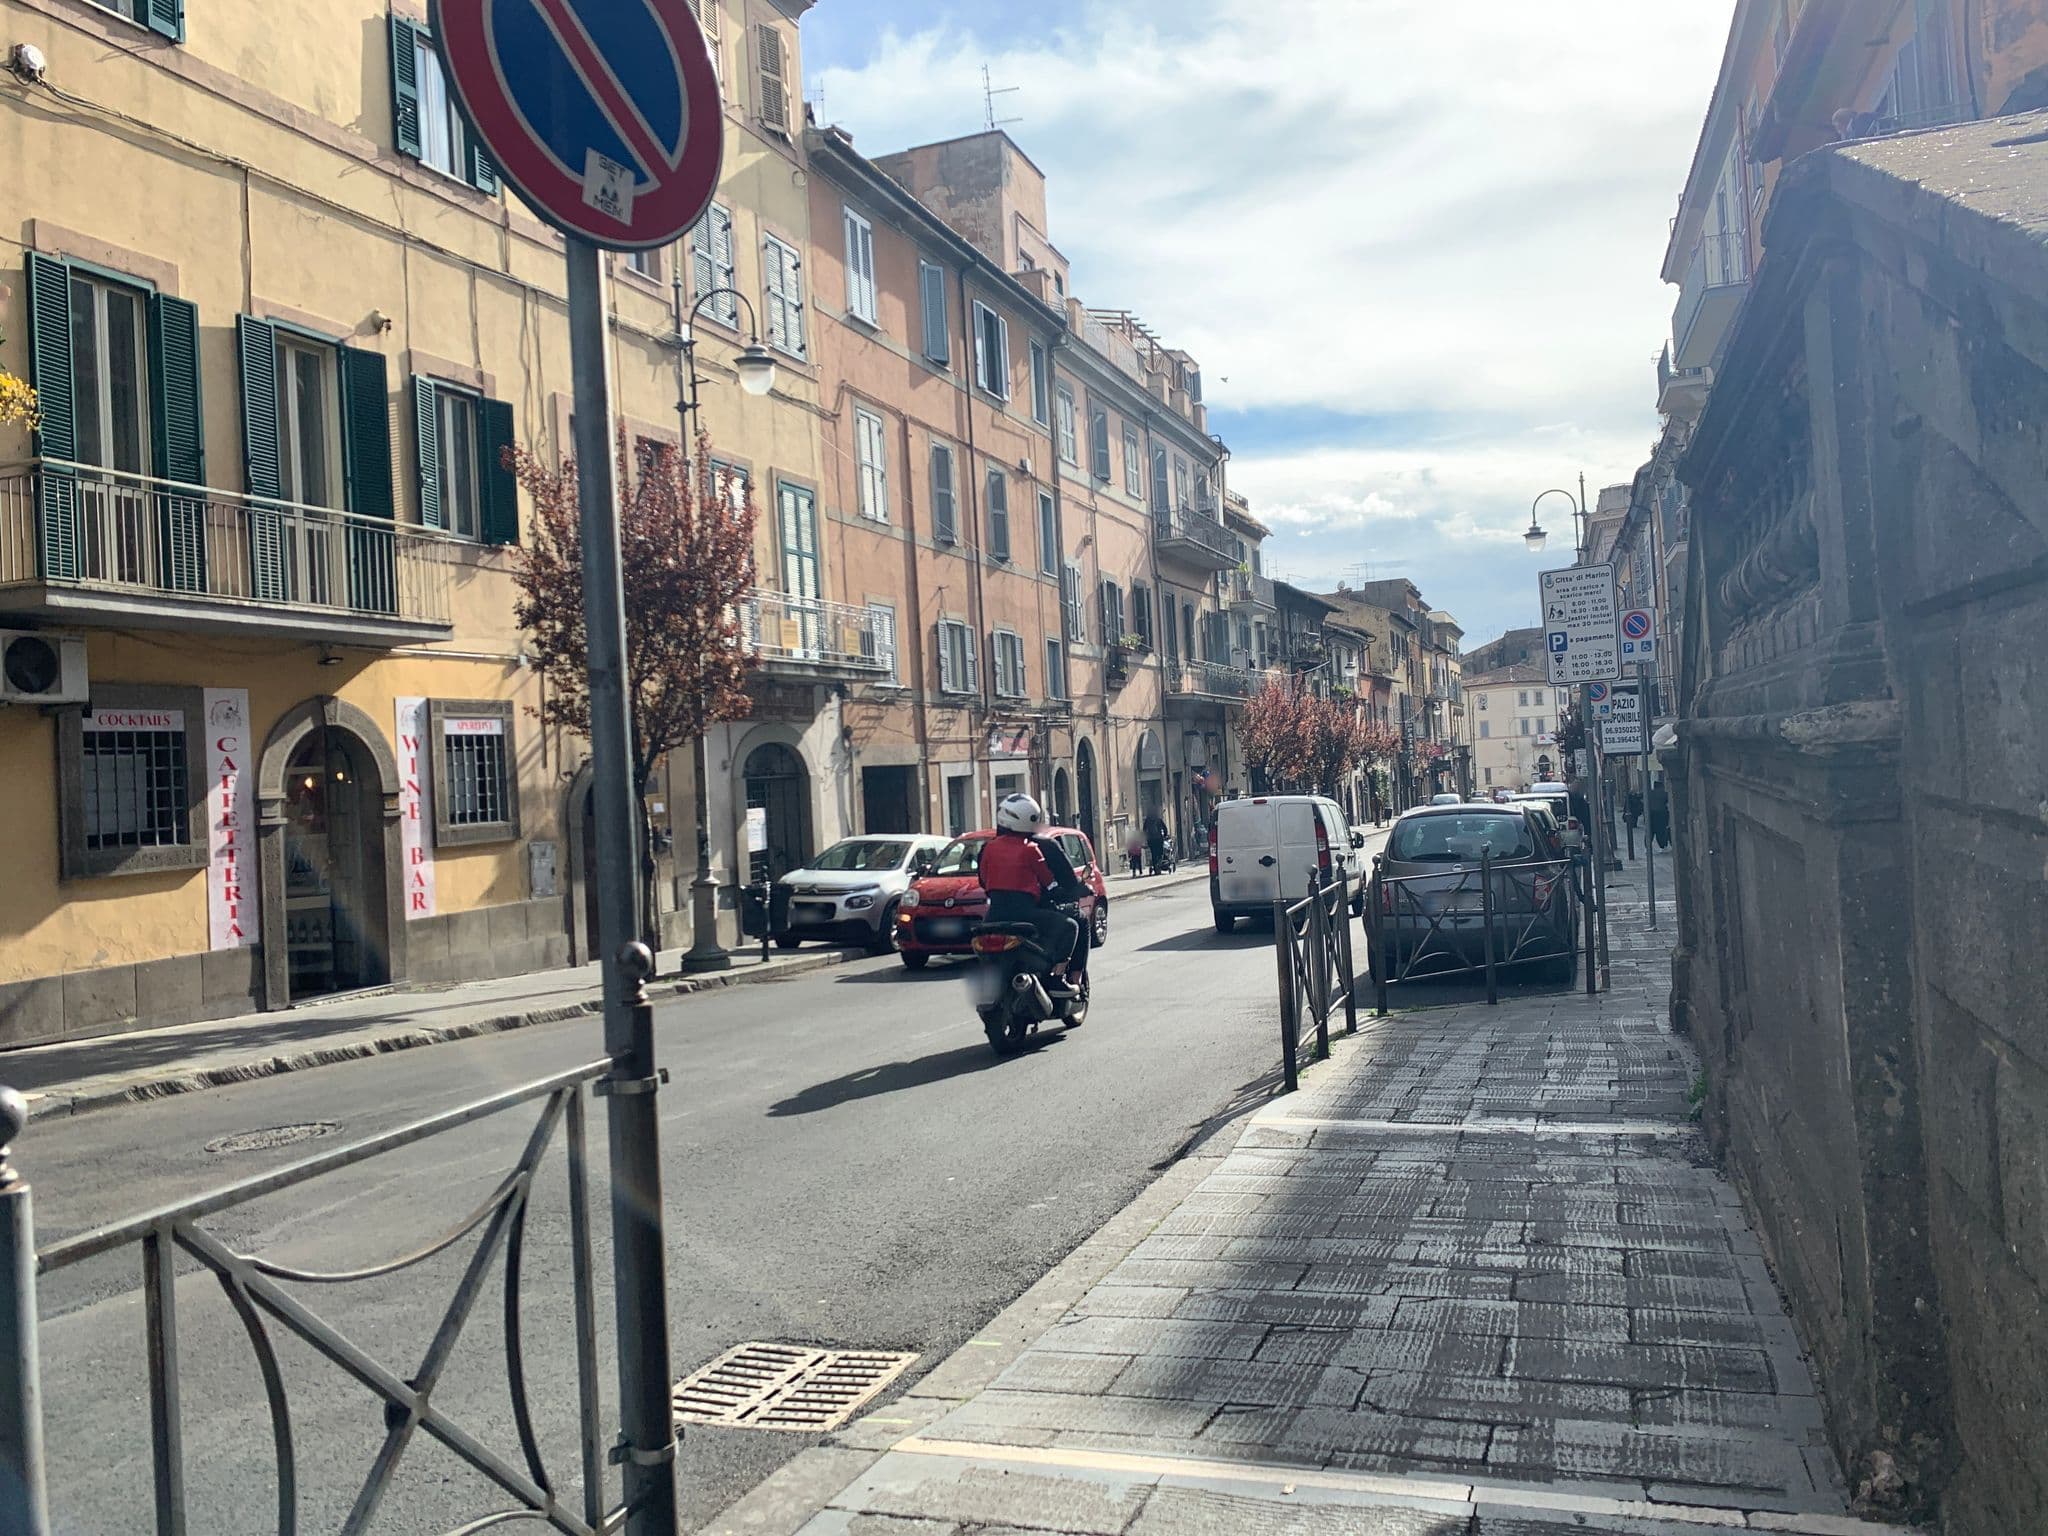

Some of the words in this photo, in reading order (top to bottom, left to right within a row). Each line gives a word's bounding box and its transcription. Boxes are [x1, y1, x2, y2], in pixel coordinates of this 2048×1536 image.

[1585, 571, 1610, 579] Marino
[1568, 613, 1589, 621] festivi
[1590, 611, 1612, 619] inclusi
[1551, 634, 1564, 650] P
[1575, 633, 1614, 643] pagamento
[1612, 698, 1635, 709] PAZIO
[98, 714, 171, 726] COCKTAILS
[401, 734, 423, 820] WINE
[216, 736, 244, 941] CAFFETTERIA
[410, 847, 426, 910] BAR
